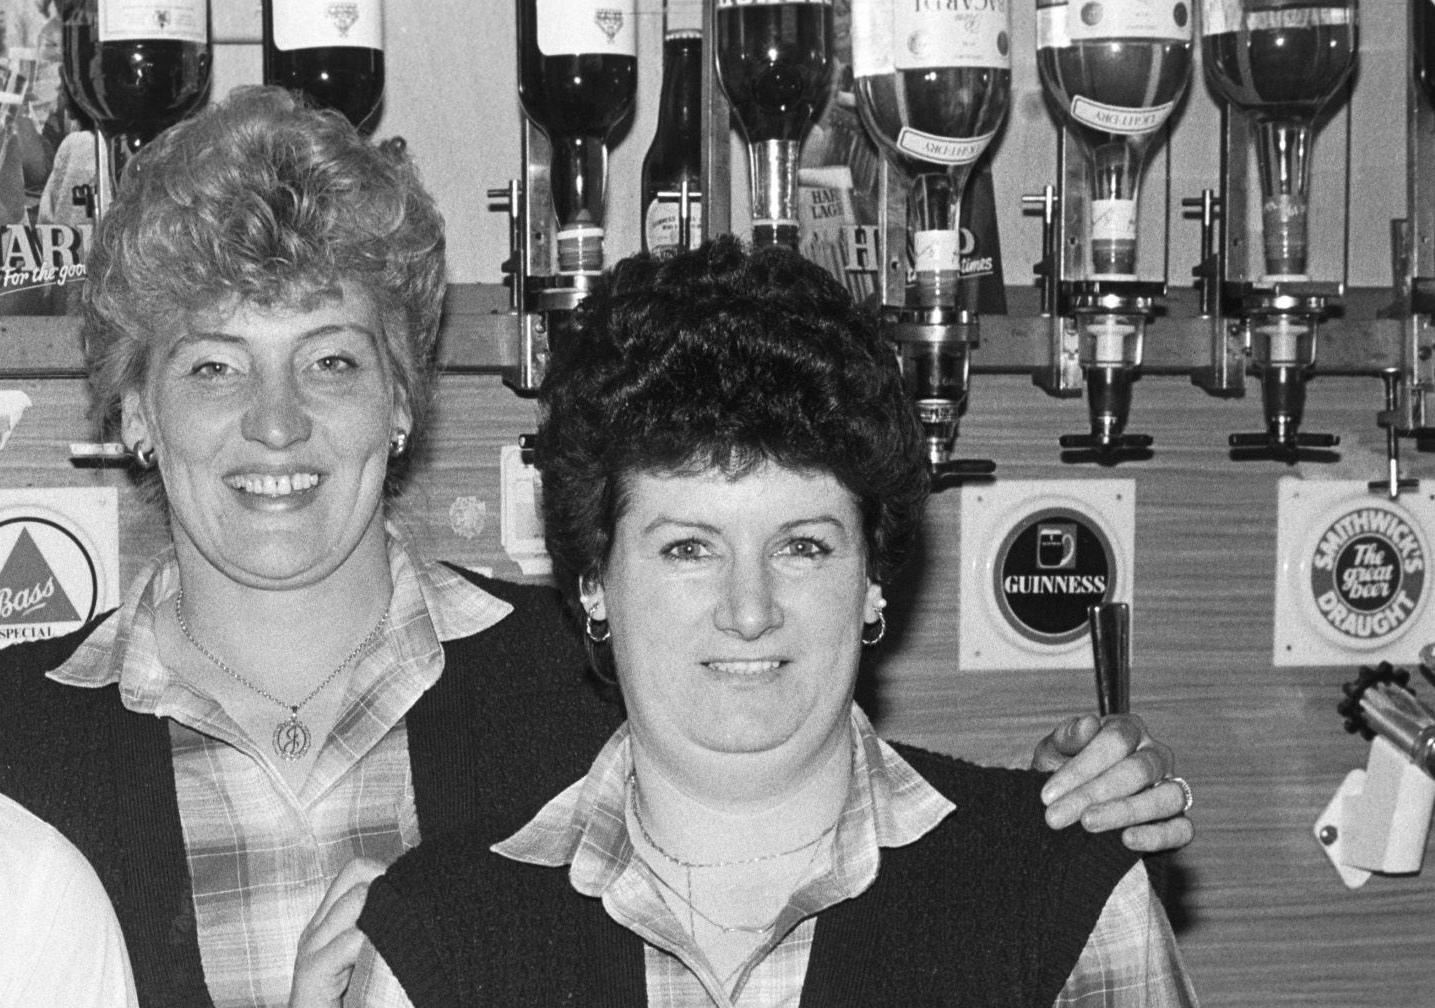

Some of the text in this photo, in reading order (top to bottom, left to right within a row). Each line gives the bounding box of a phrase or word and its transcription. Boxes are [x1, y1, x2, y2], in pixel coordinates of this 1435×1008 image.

[3, 269, 29, 288] For
[32, 261, 55, 283] the
[1314, 510, 1424, 573] SMITHWICK'S
[1355, 543, 1385, 566] The
[1004, 575, 1106, 594] GUINNESS
[1342, 565, 1393, 591] great
[1349, 581, 1390, 599] beer
[1318, 590, 1414, 637] DRAUGHT
